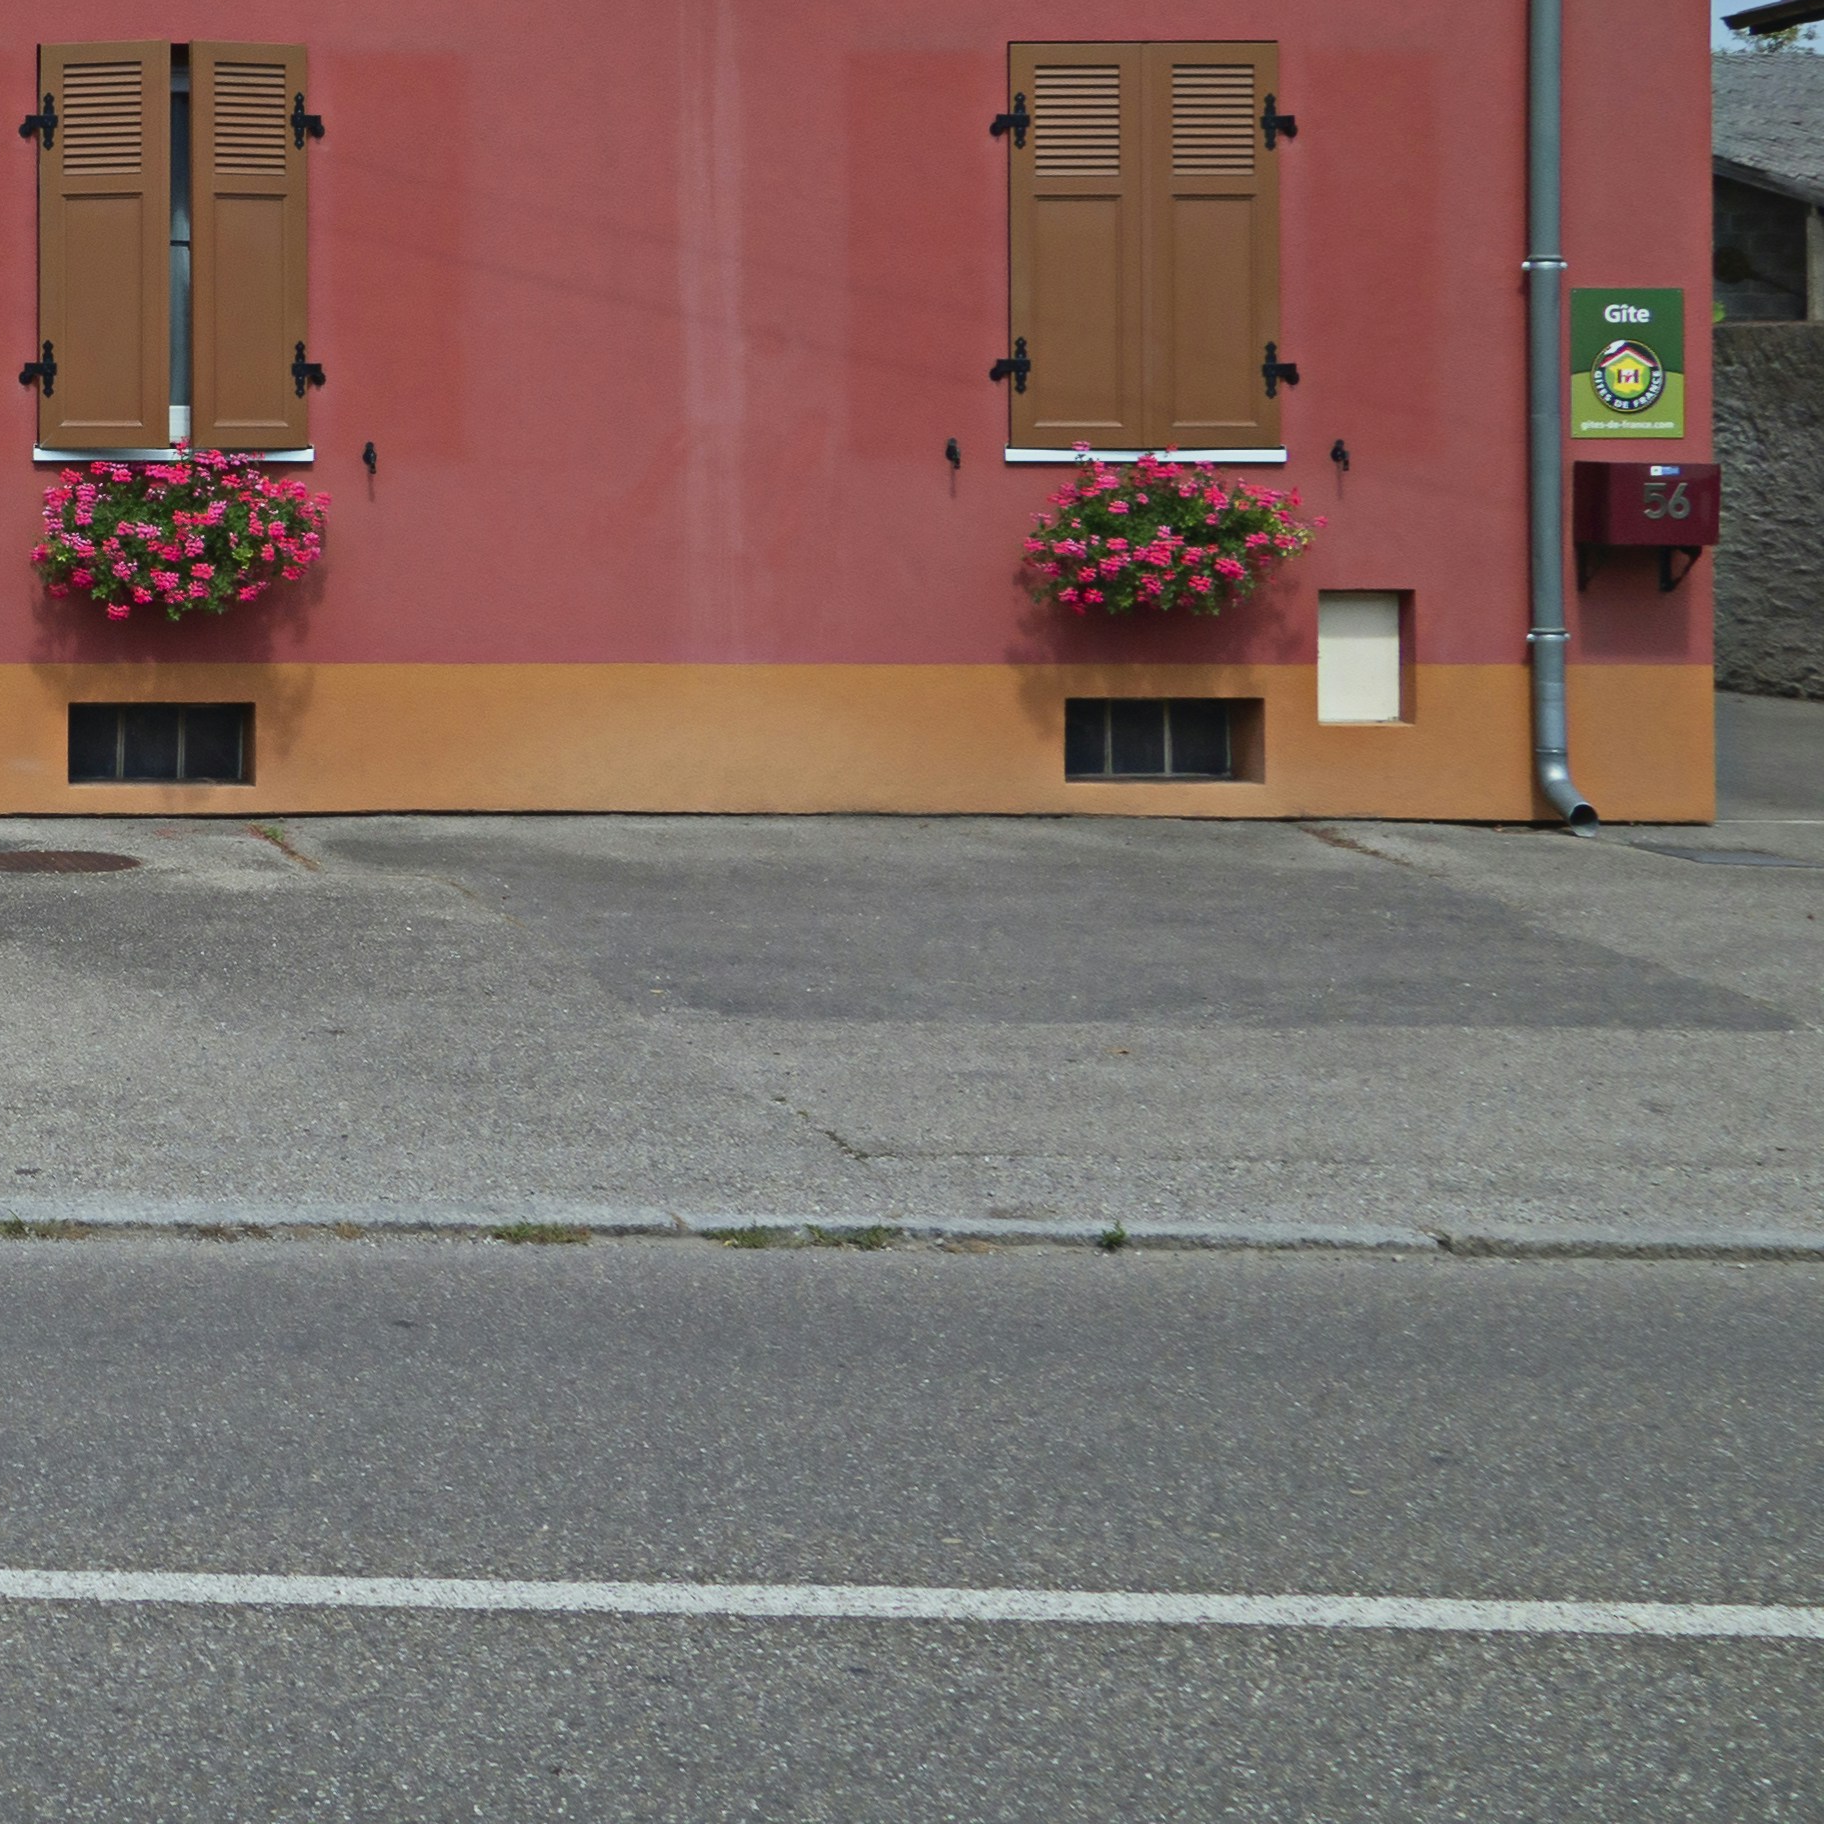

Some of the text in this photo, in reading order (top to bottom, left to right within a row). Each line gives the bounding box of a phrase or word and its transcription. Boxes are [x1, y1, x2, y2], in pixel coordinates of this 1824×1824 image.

[1604, 304, 1650, 323] Gîte
[1614, 399, 1629, 409] DE
[1633, 371, 1661, 408] FRANCE
[1643, 482, 1691, 519] 56
